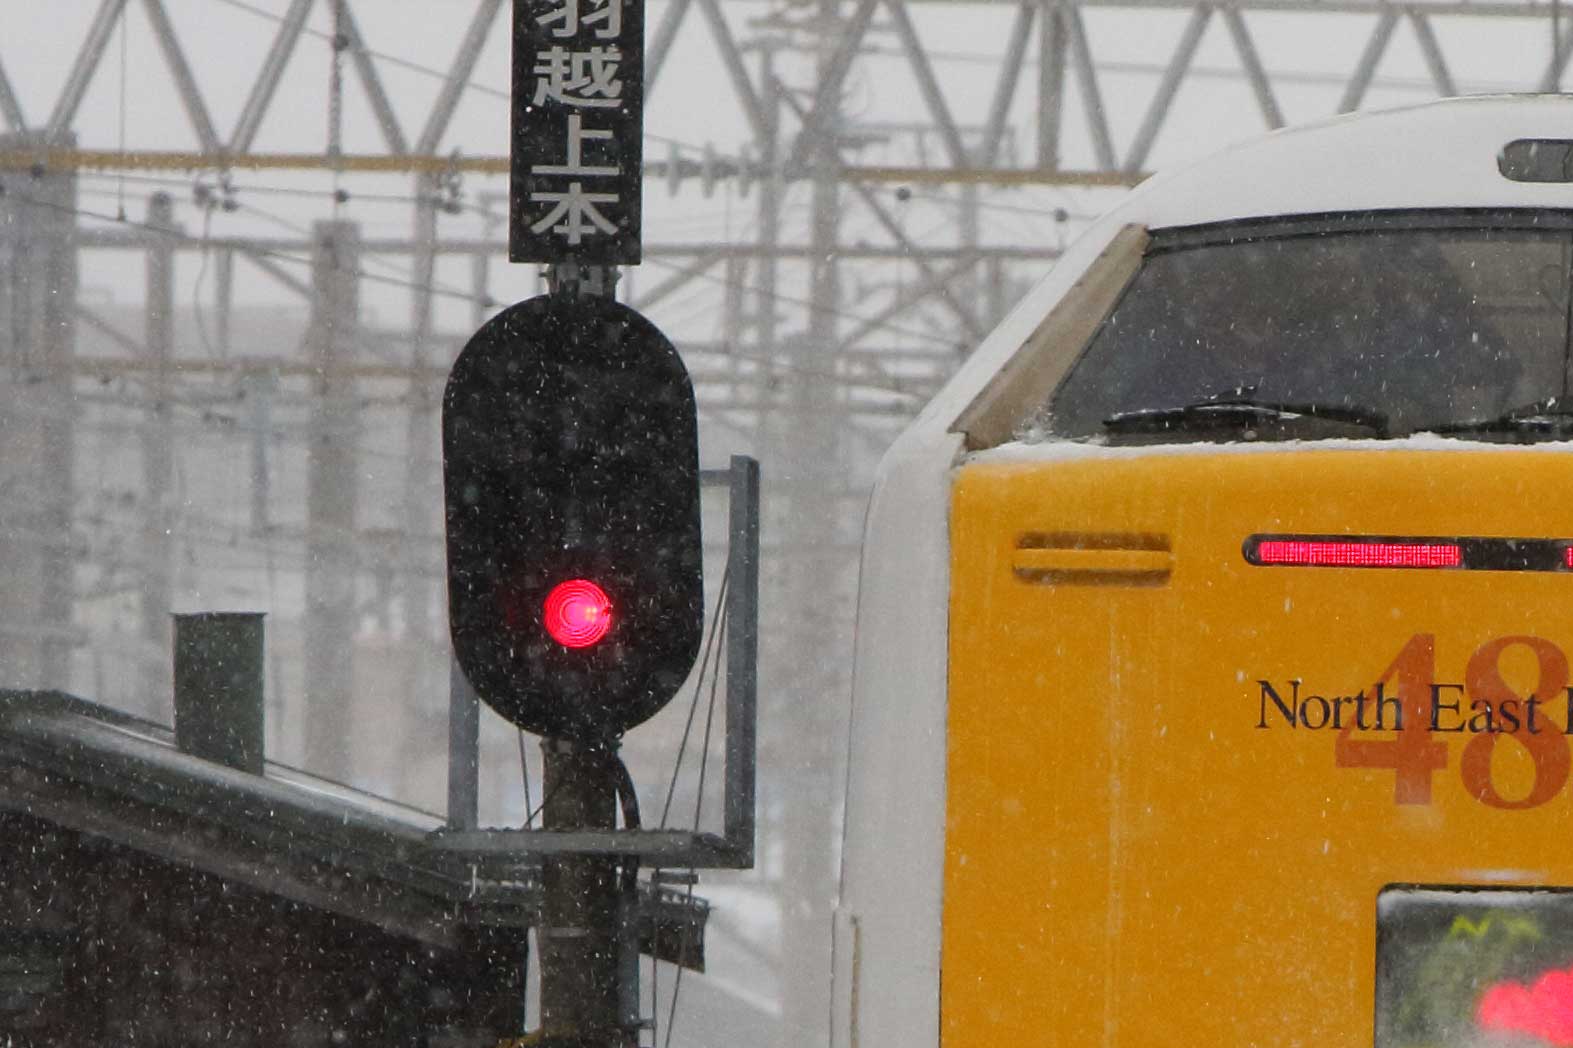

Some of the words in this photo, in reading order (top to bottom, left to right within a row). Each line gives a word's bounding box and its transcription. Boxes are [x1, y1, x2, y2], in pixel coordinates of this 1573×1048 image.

[530, 0, 623, 244] 羽越上本
[1256, 679, 1404, 731] North
[1428, 683, 1543, 735] East
